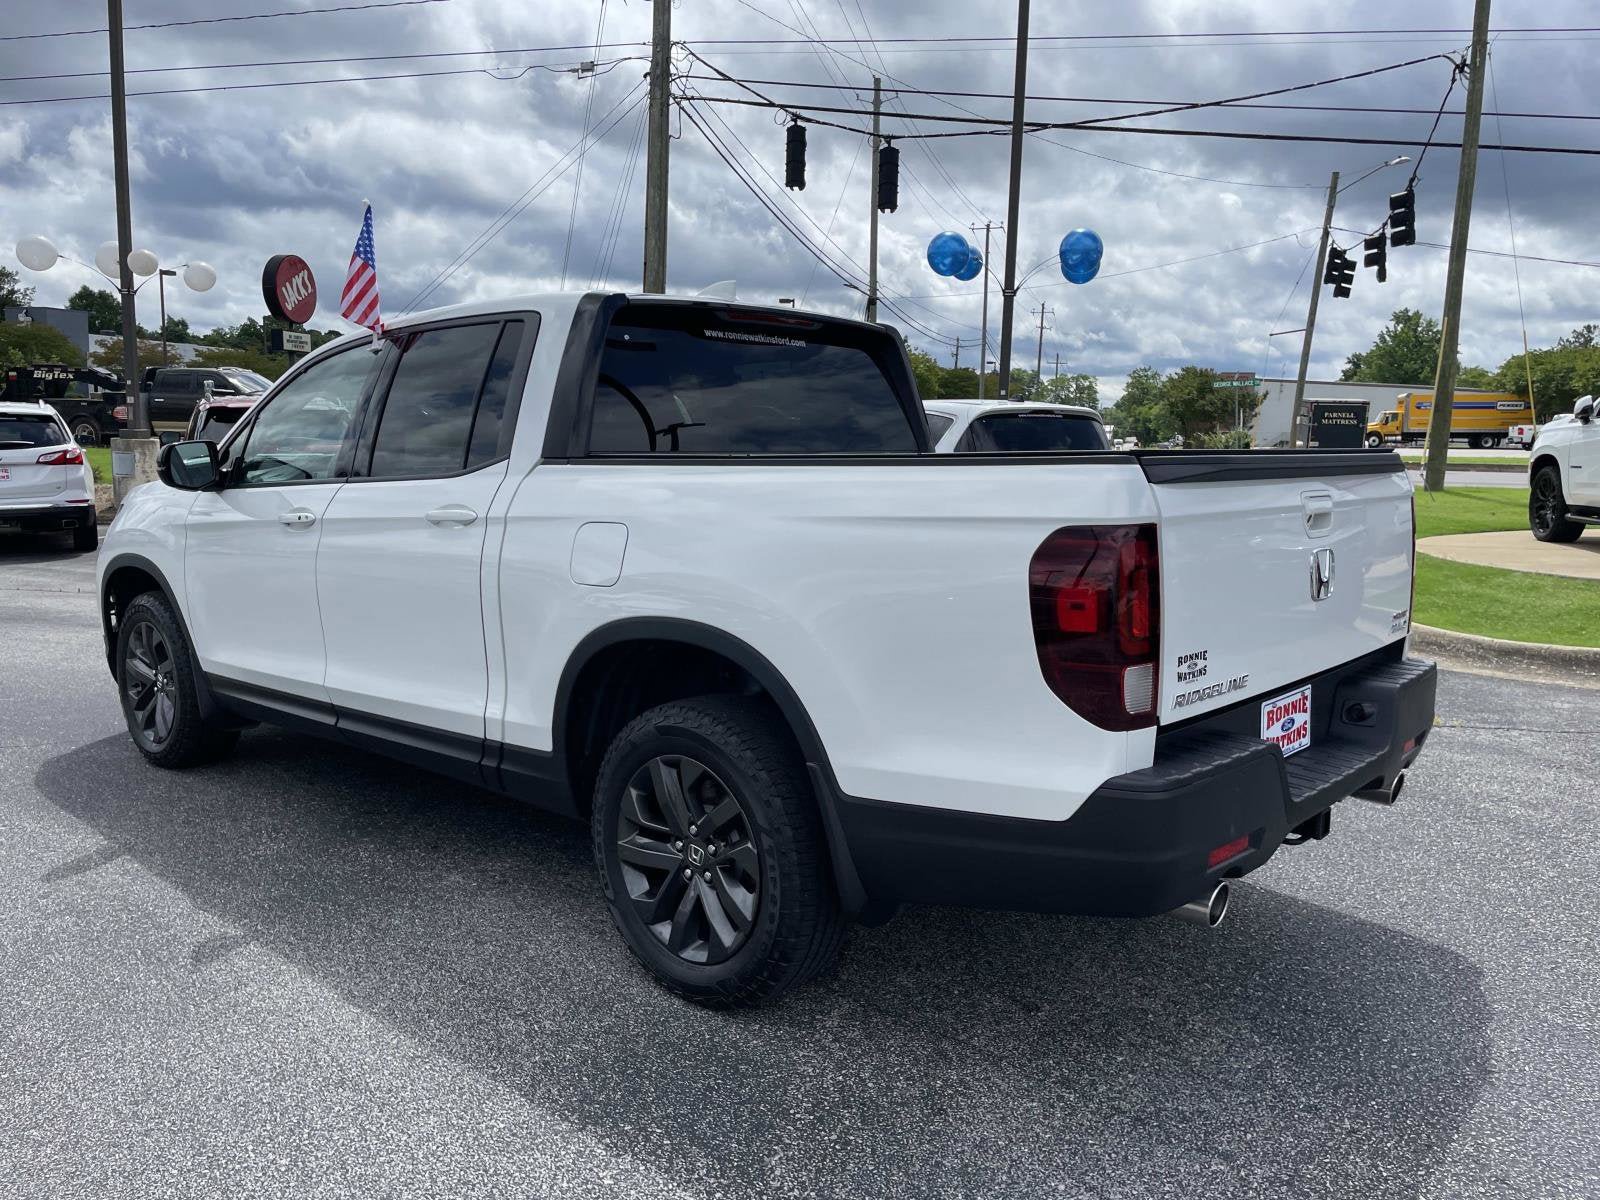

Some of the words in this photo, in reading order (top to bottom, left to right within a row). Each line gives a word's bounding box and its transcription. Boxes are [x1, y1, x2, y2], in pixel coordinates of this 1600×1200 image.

[703, 329, 806, 347] www.ronniewatkinsford.com
[1177, 650, 1208, 667] RONNIE
[1177, 665, 1208, 683] WATKINS
[1171, 674, 1249, 709] RIDGELINE
[1266, 694, 1309, 731] RONNIE
[1265, 719, 1308, 749] TKINS
